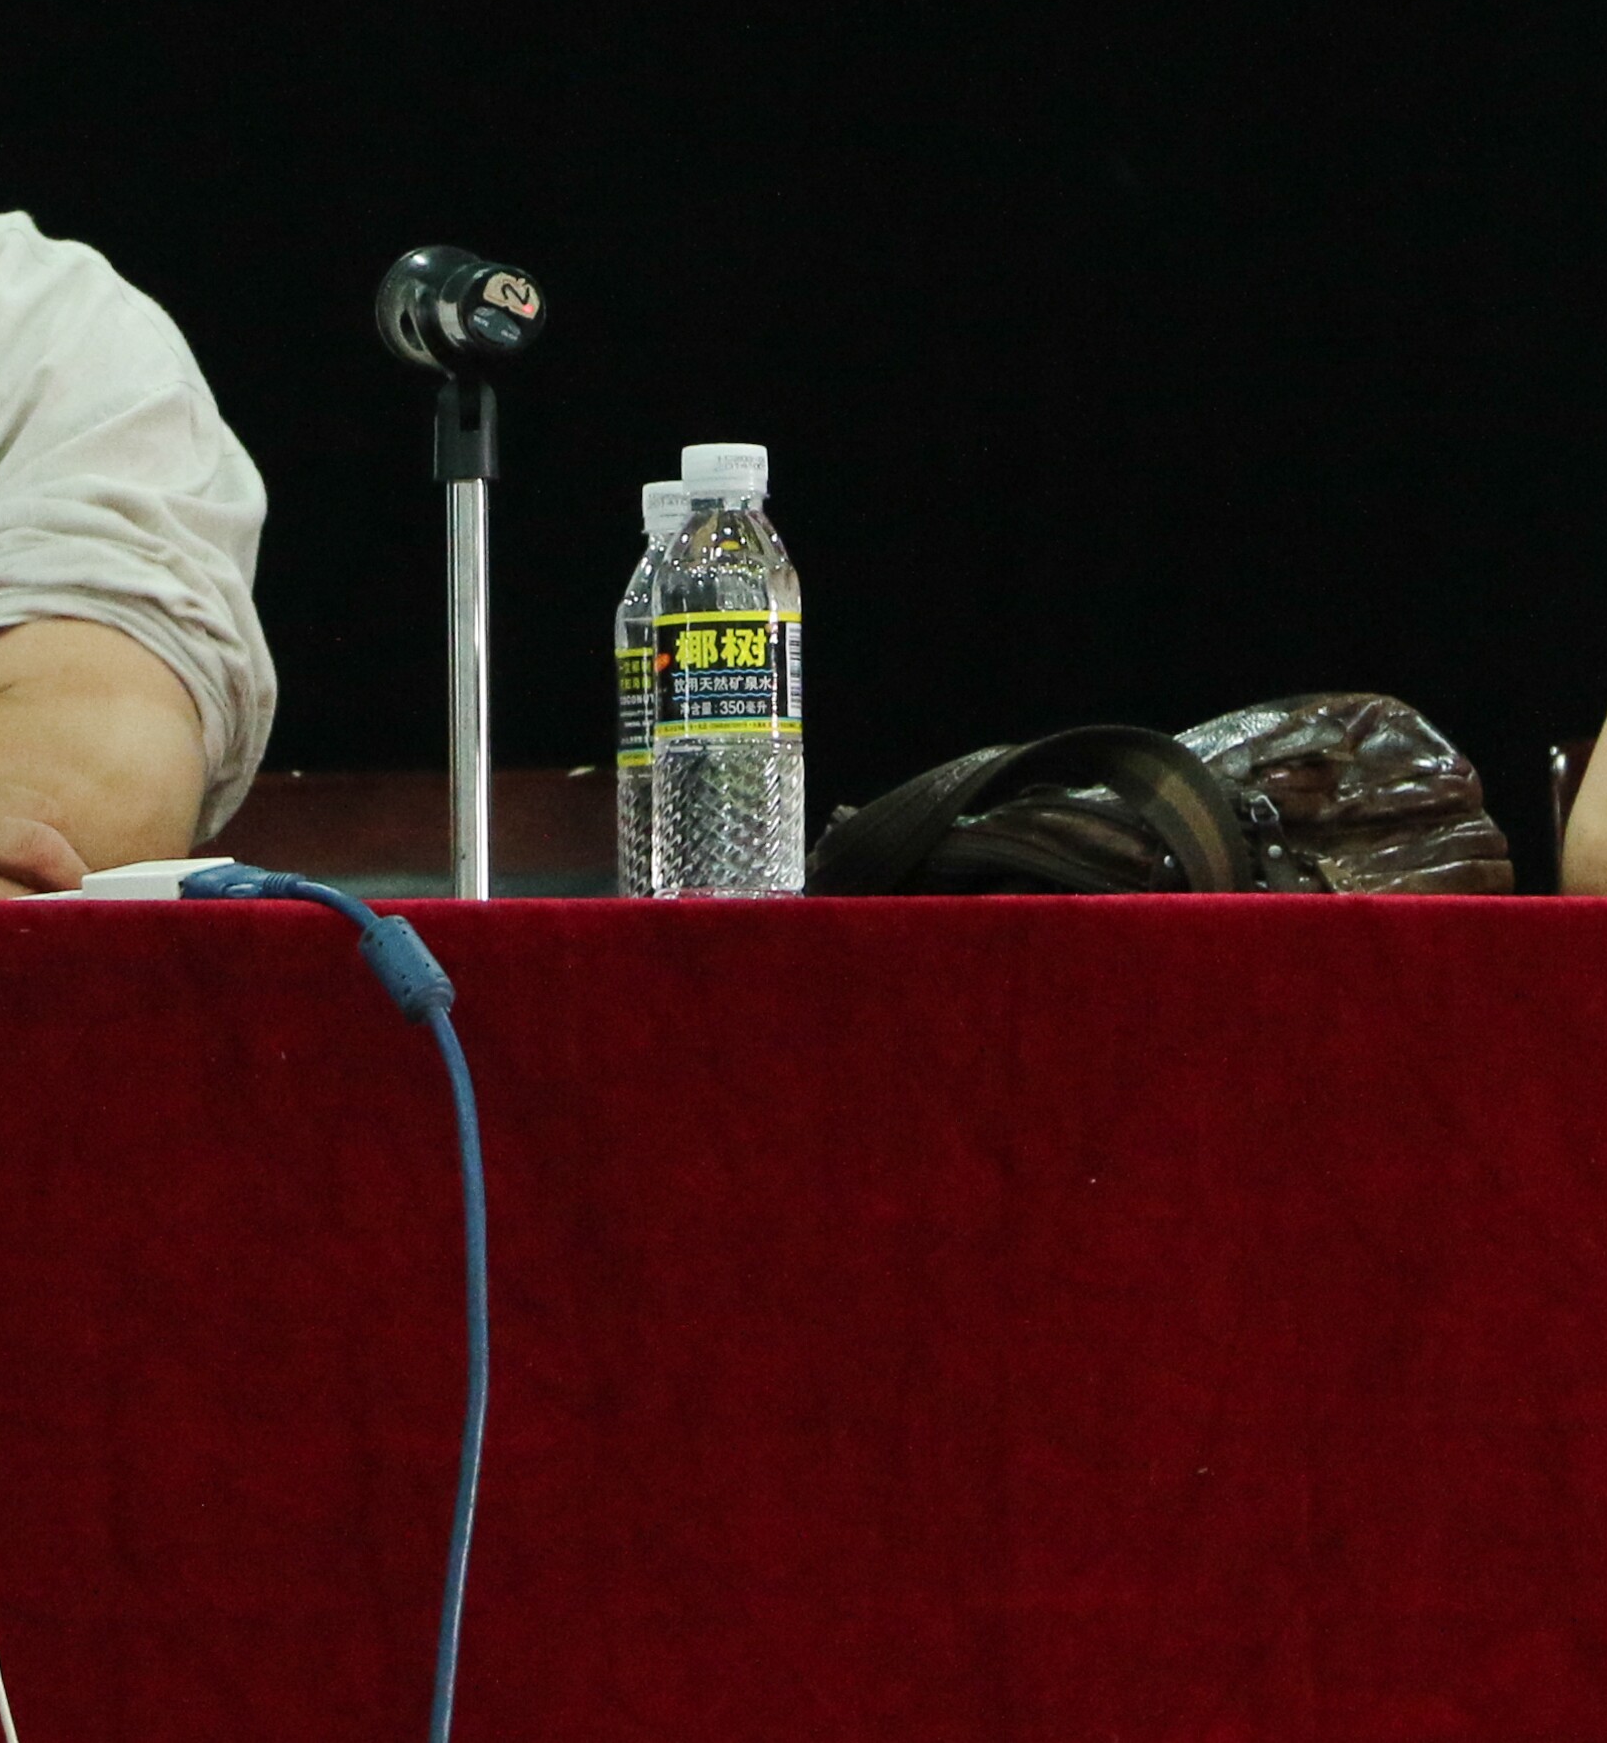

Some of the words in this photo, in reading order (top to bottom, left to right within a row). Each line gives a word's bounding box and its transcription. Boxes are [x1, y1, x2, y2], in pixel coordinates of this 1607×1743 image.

[501, 283, 530, 305] 2
[675, 628, 767, 670] 椰树
[674, 676, 772, 693] 饮用天然矿泉水
